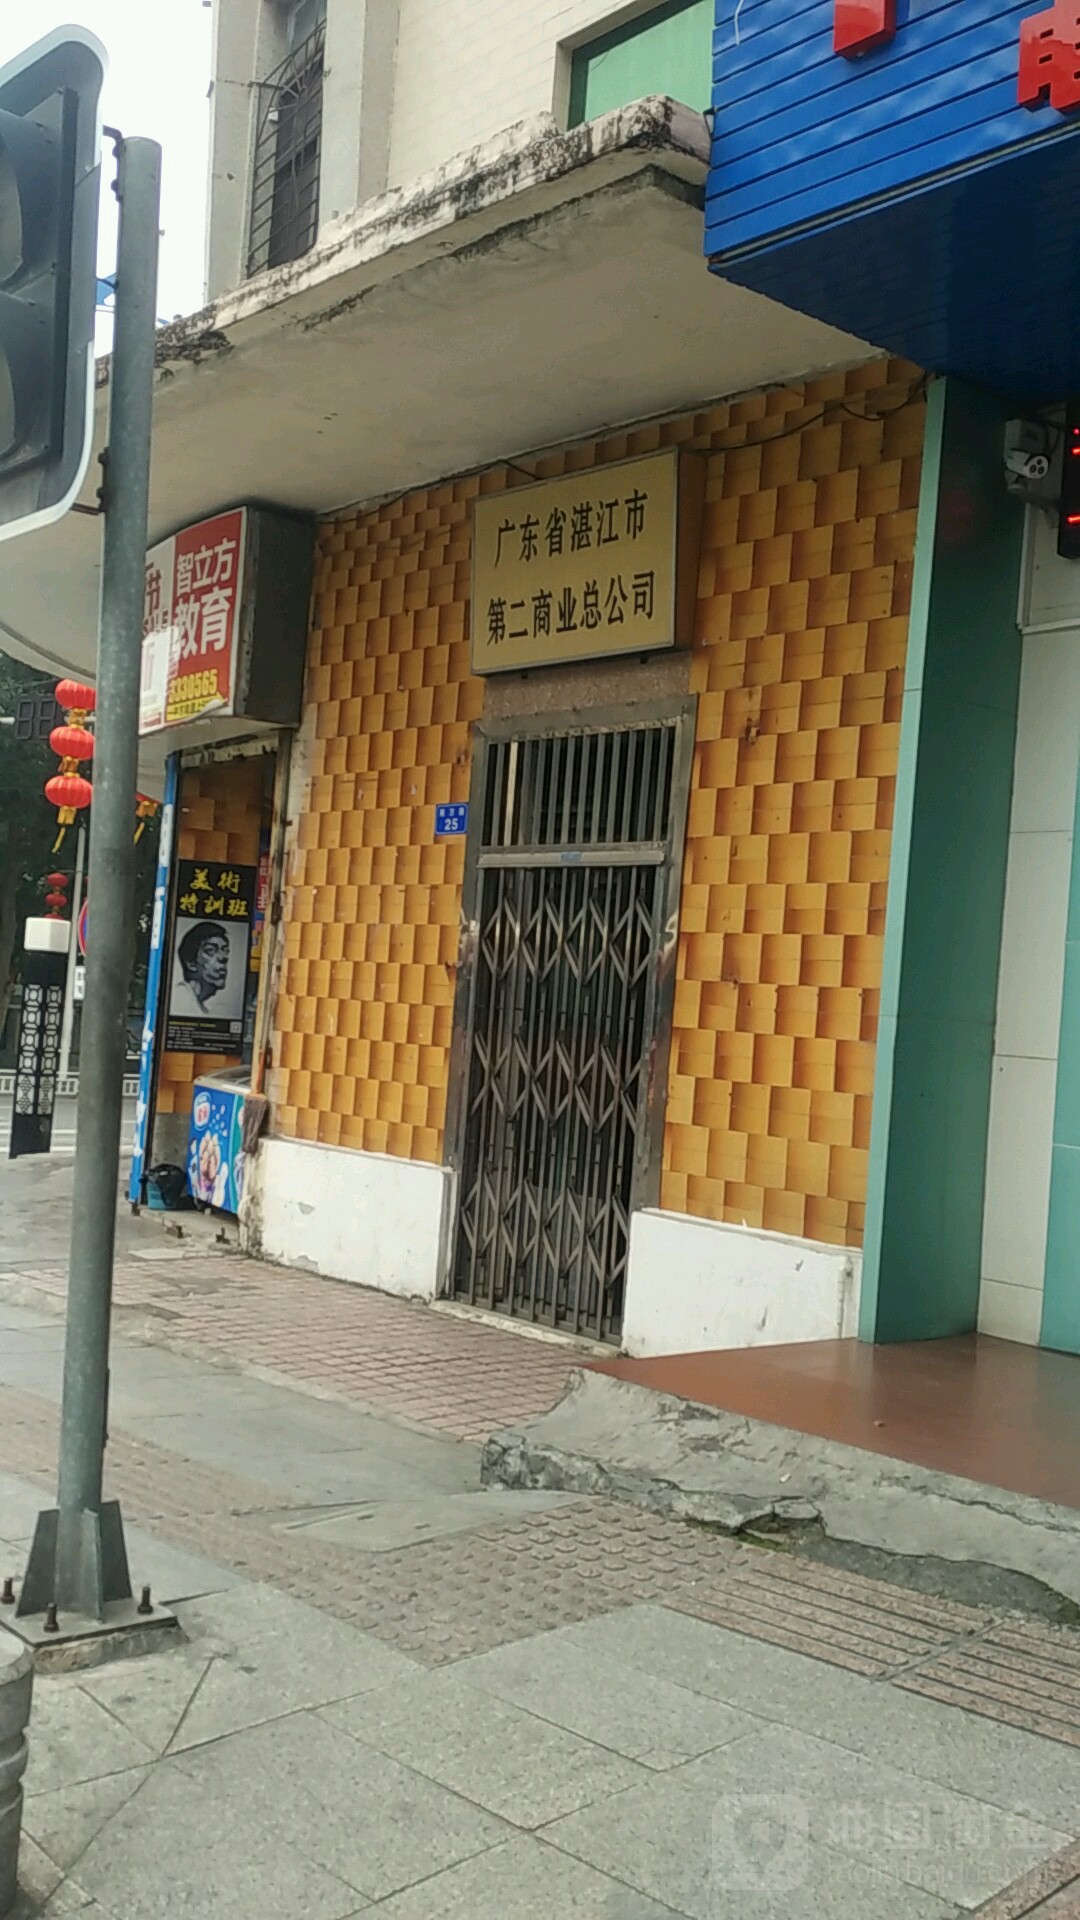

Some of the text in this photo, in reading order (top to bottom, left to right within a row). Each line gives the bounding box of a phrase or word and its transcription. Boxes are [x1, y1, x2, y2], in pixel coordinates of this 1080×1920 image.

[494, 489, 648, 568] 广东省湛江市
[177, 537, 236, 597] 智立方
[174, 585, 233, 659] 教育
[487, 570, 656, 656] 第二商业总公司
[444, 818, 459, 831] 25
